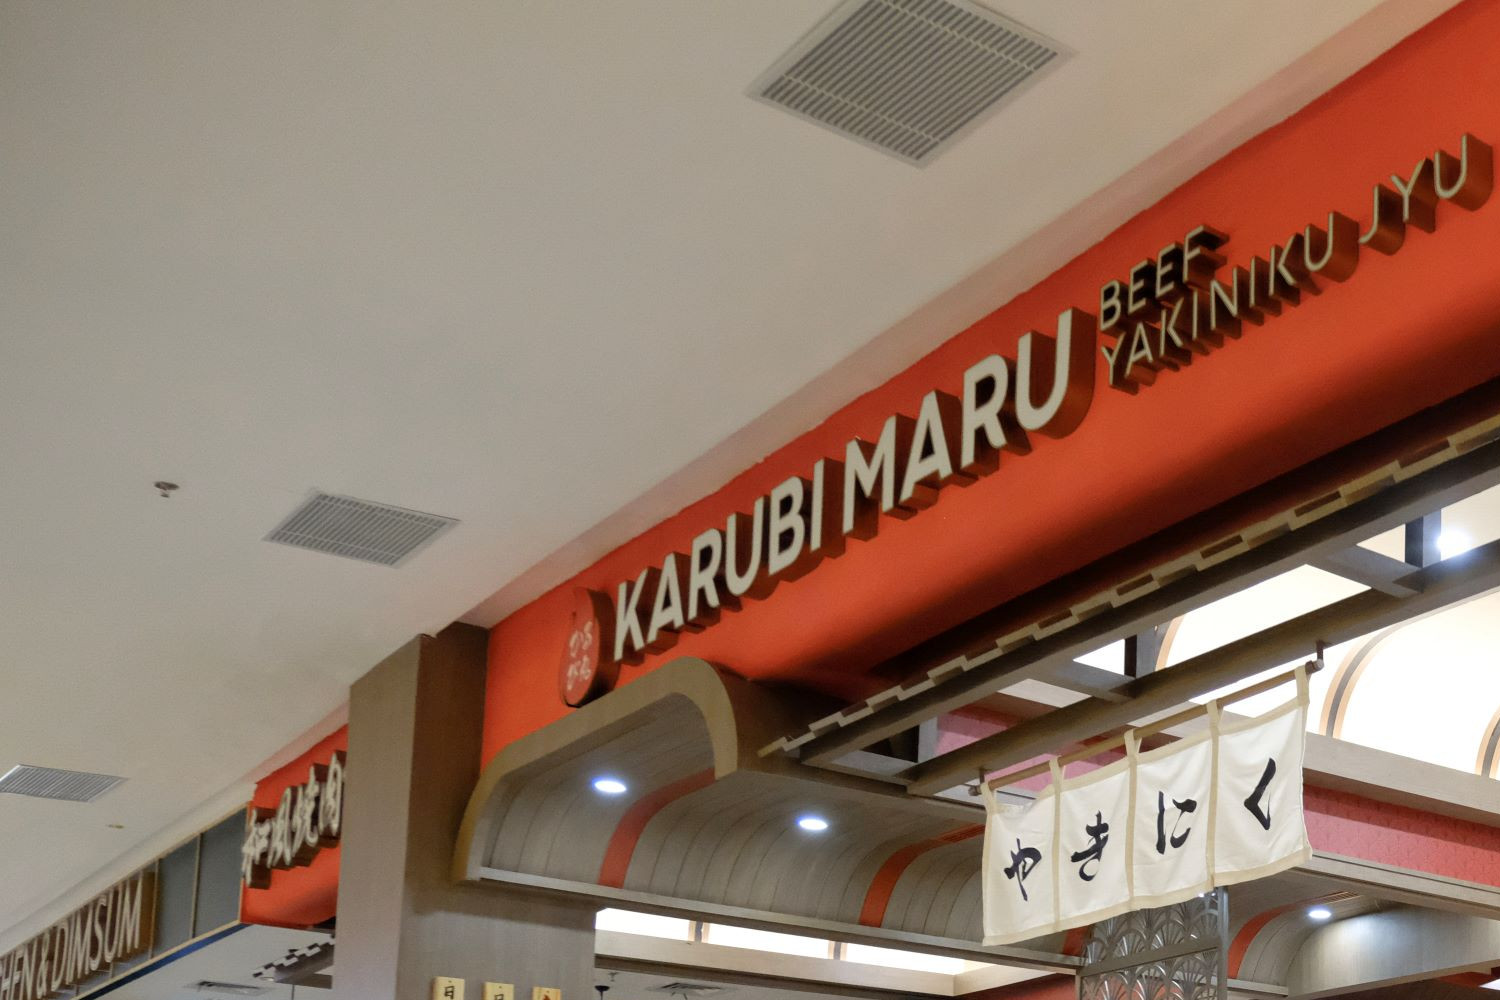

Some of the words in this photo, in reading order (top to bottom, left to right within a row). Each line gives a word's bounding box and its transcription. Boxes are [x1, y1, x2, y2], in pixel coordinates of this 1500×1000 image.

[1100, 225, 1208, 331] BEEF
[1101, 211, 1336, 387] YAKINIKU
[1359, 132, 1468, 245] JYU
[614, 457, 825, 662] KARUBI
[842, 308, 1073, 535] MARU
[1003, 757, 1277, 902] やきにく
[51, 868, 144, 993] DIMSUM
